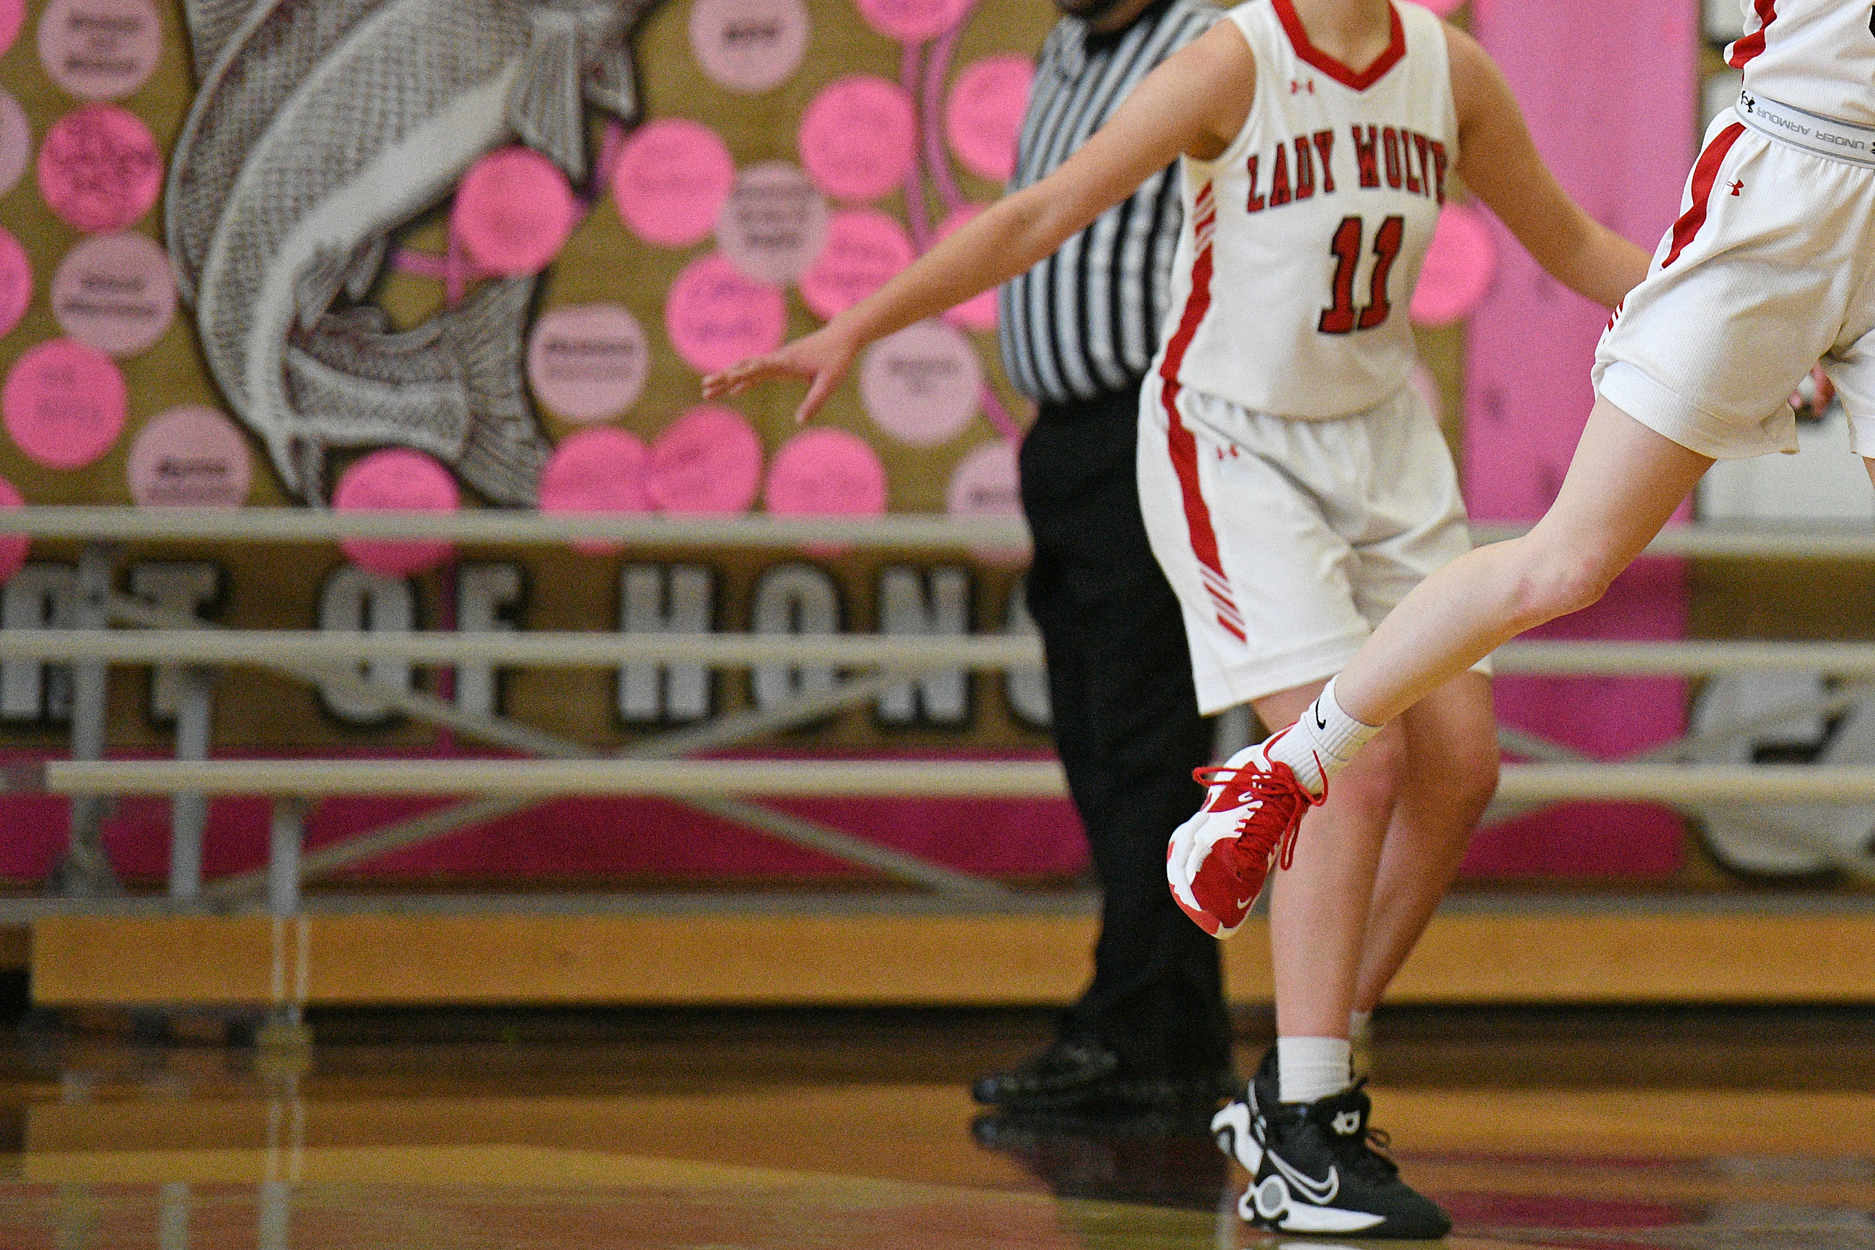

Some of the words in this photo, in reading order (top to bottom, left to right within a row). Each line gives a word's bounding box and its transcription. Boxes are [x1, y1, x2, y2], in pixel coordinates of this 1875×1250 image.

[1757, 107, 1811, 137] ARMOUR
[1815, 130, 1865, 151] UNDER
[1247, 128, 1336, 214] LADY
[1317, 214, 1405, 336] 11
[320, 562, 525, 724] OF
